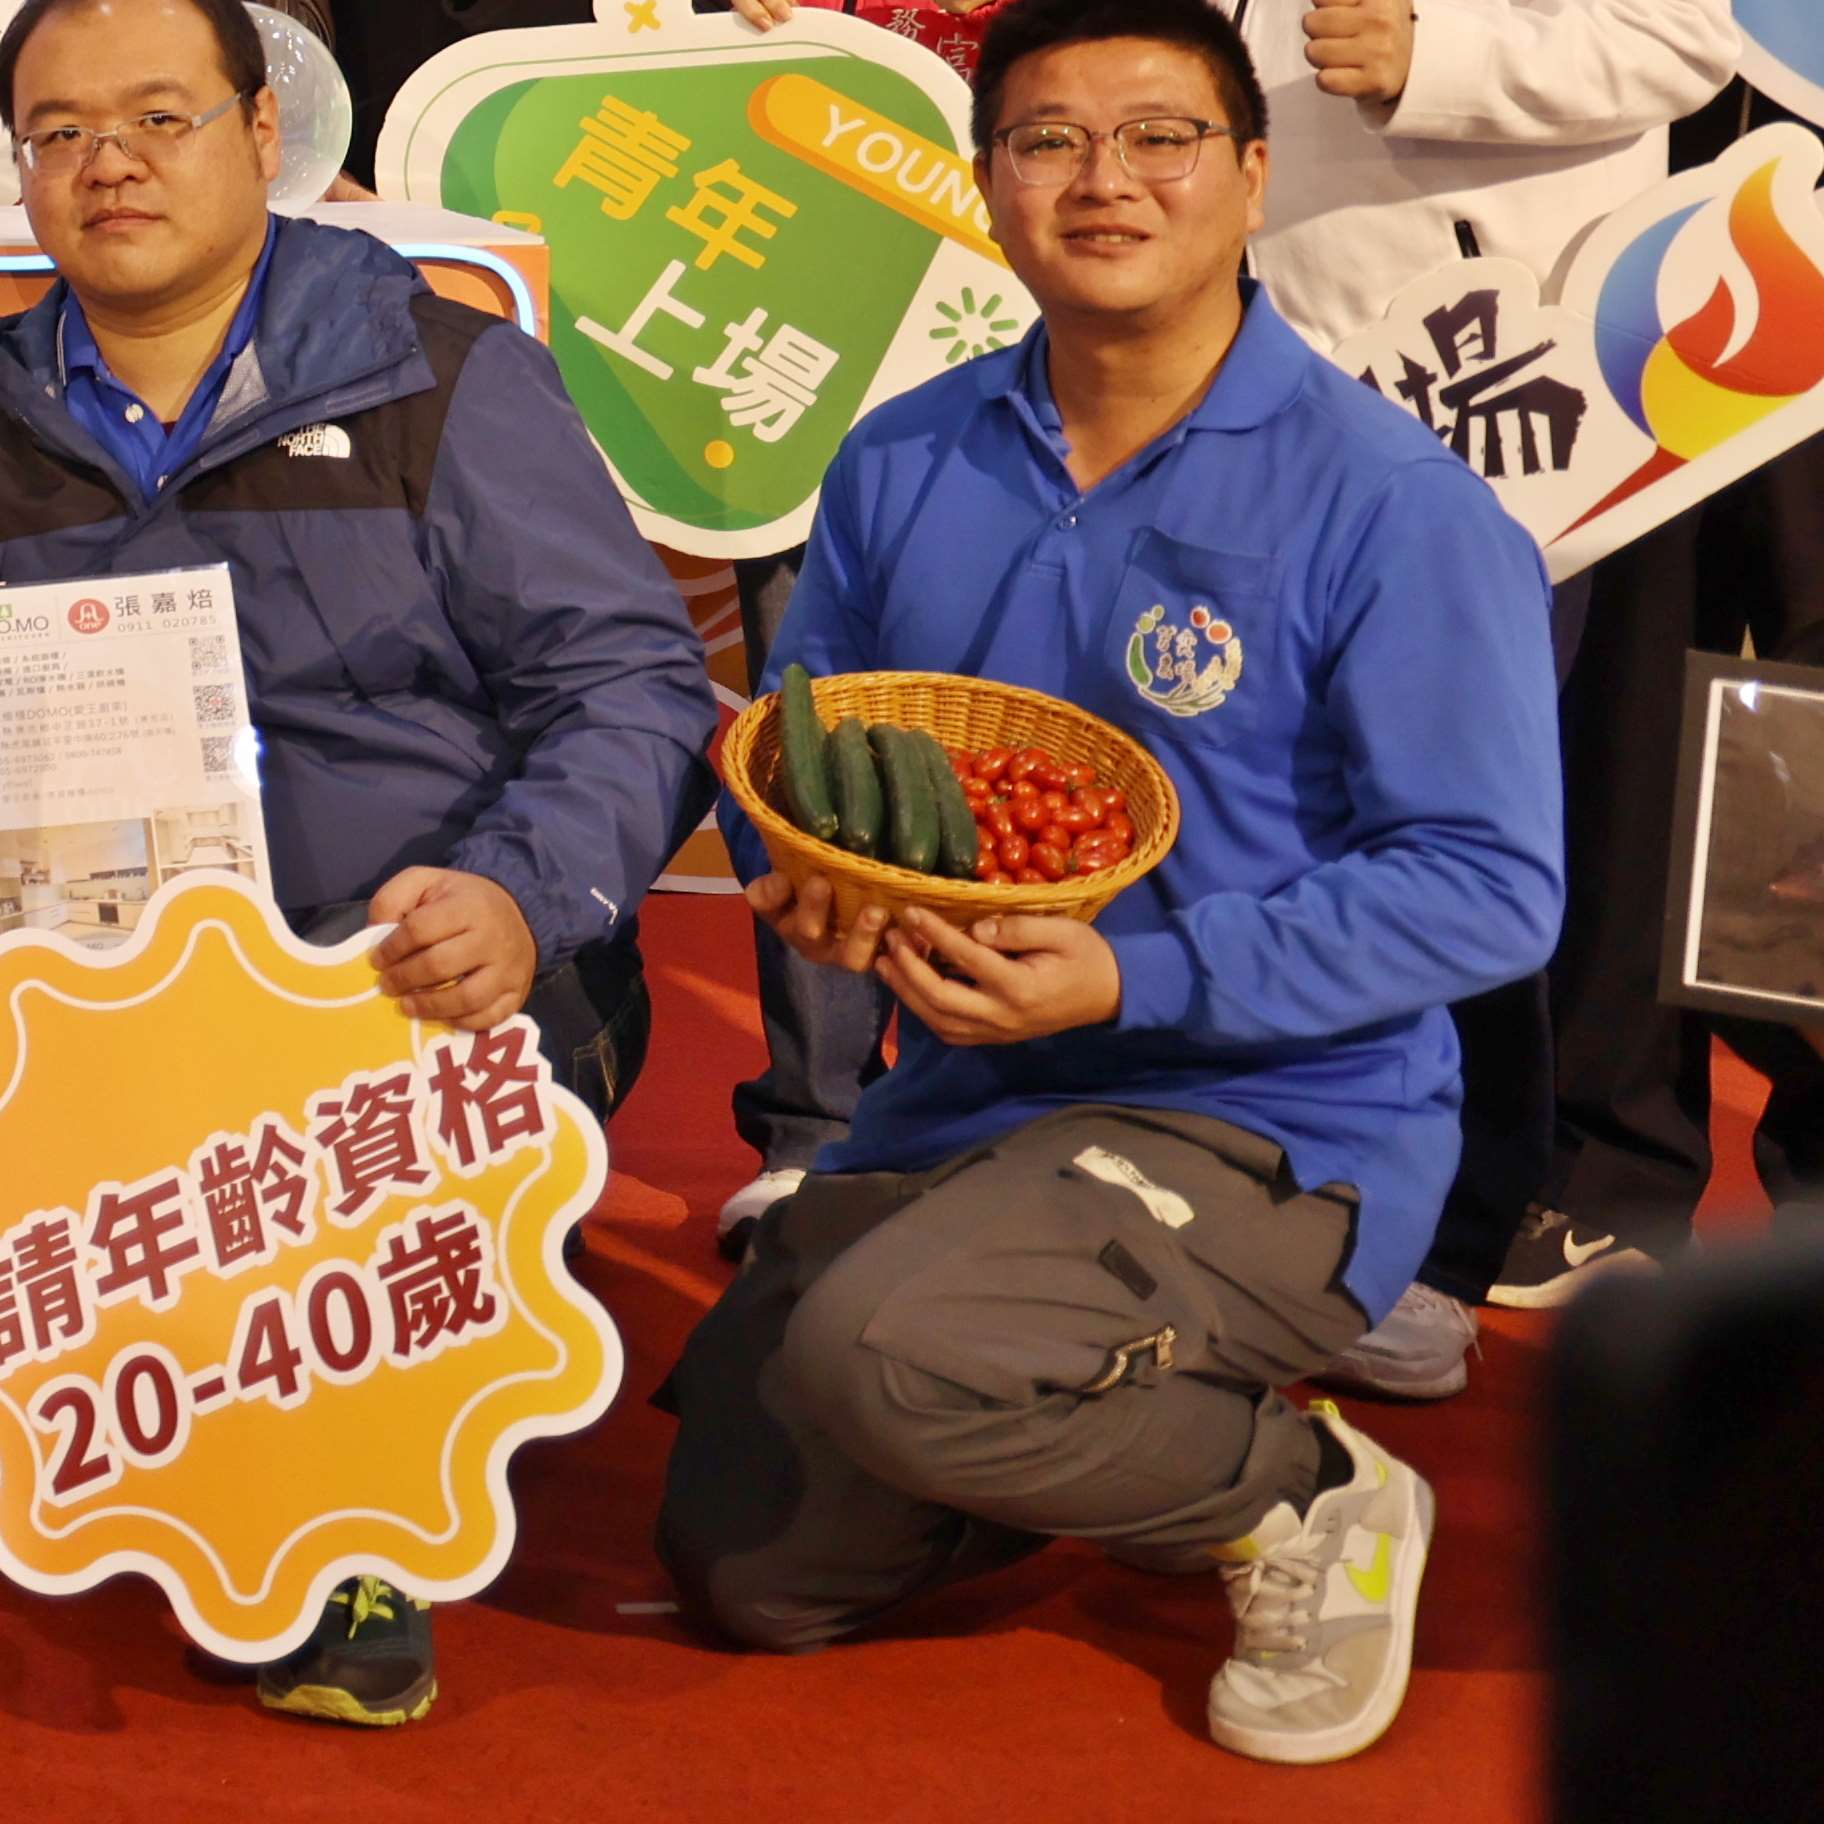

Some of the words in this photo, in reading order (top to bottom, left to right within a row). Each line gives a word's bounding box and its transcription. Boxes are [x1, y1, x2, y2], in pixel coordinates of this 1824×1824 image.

[553, 94, 798, 272] 青年
[574, 259, 840, 444] 上場
[118, 622, 153, 633] 0911
[39, 1211, 498, 1495] 20-40歲
